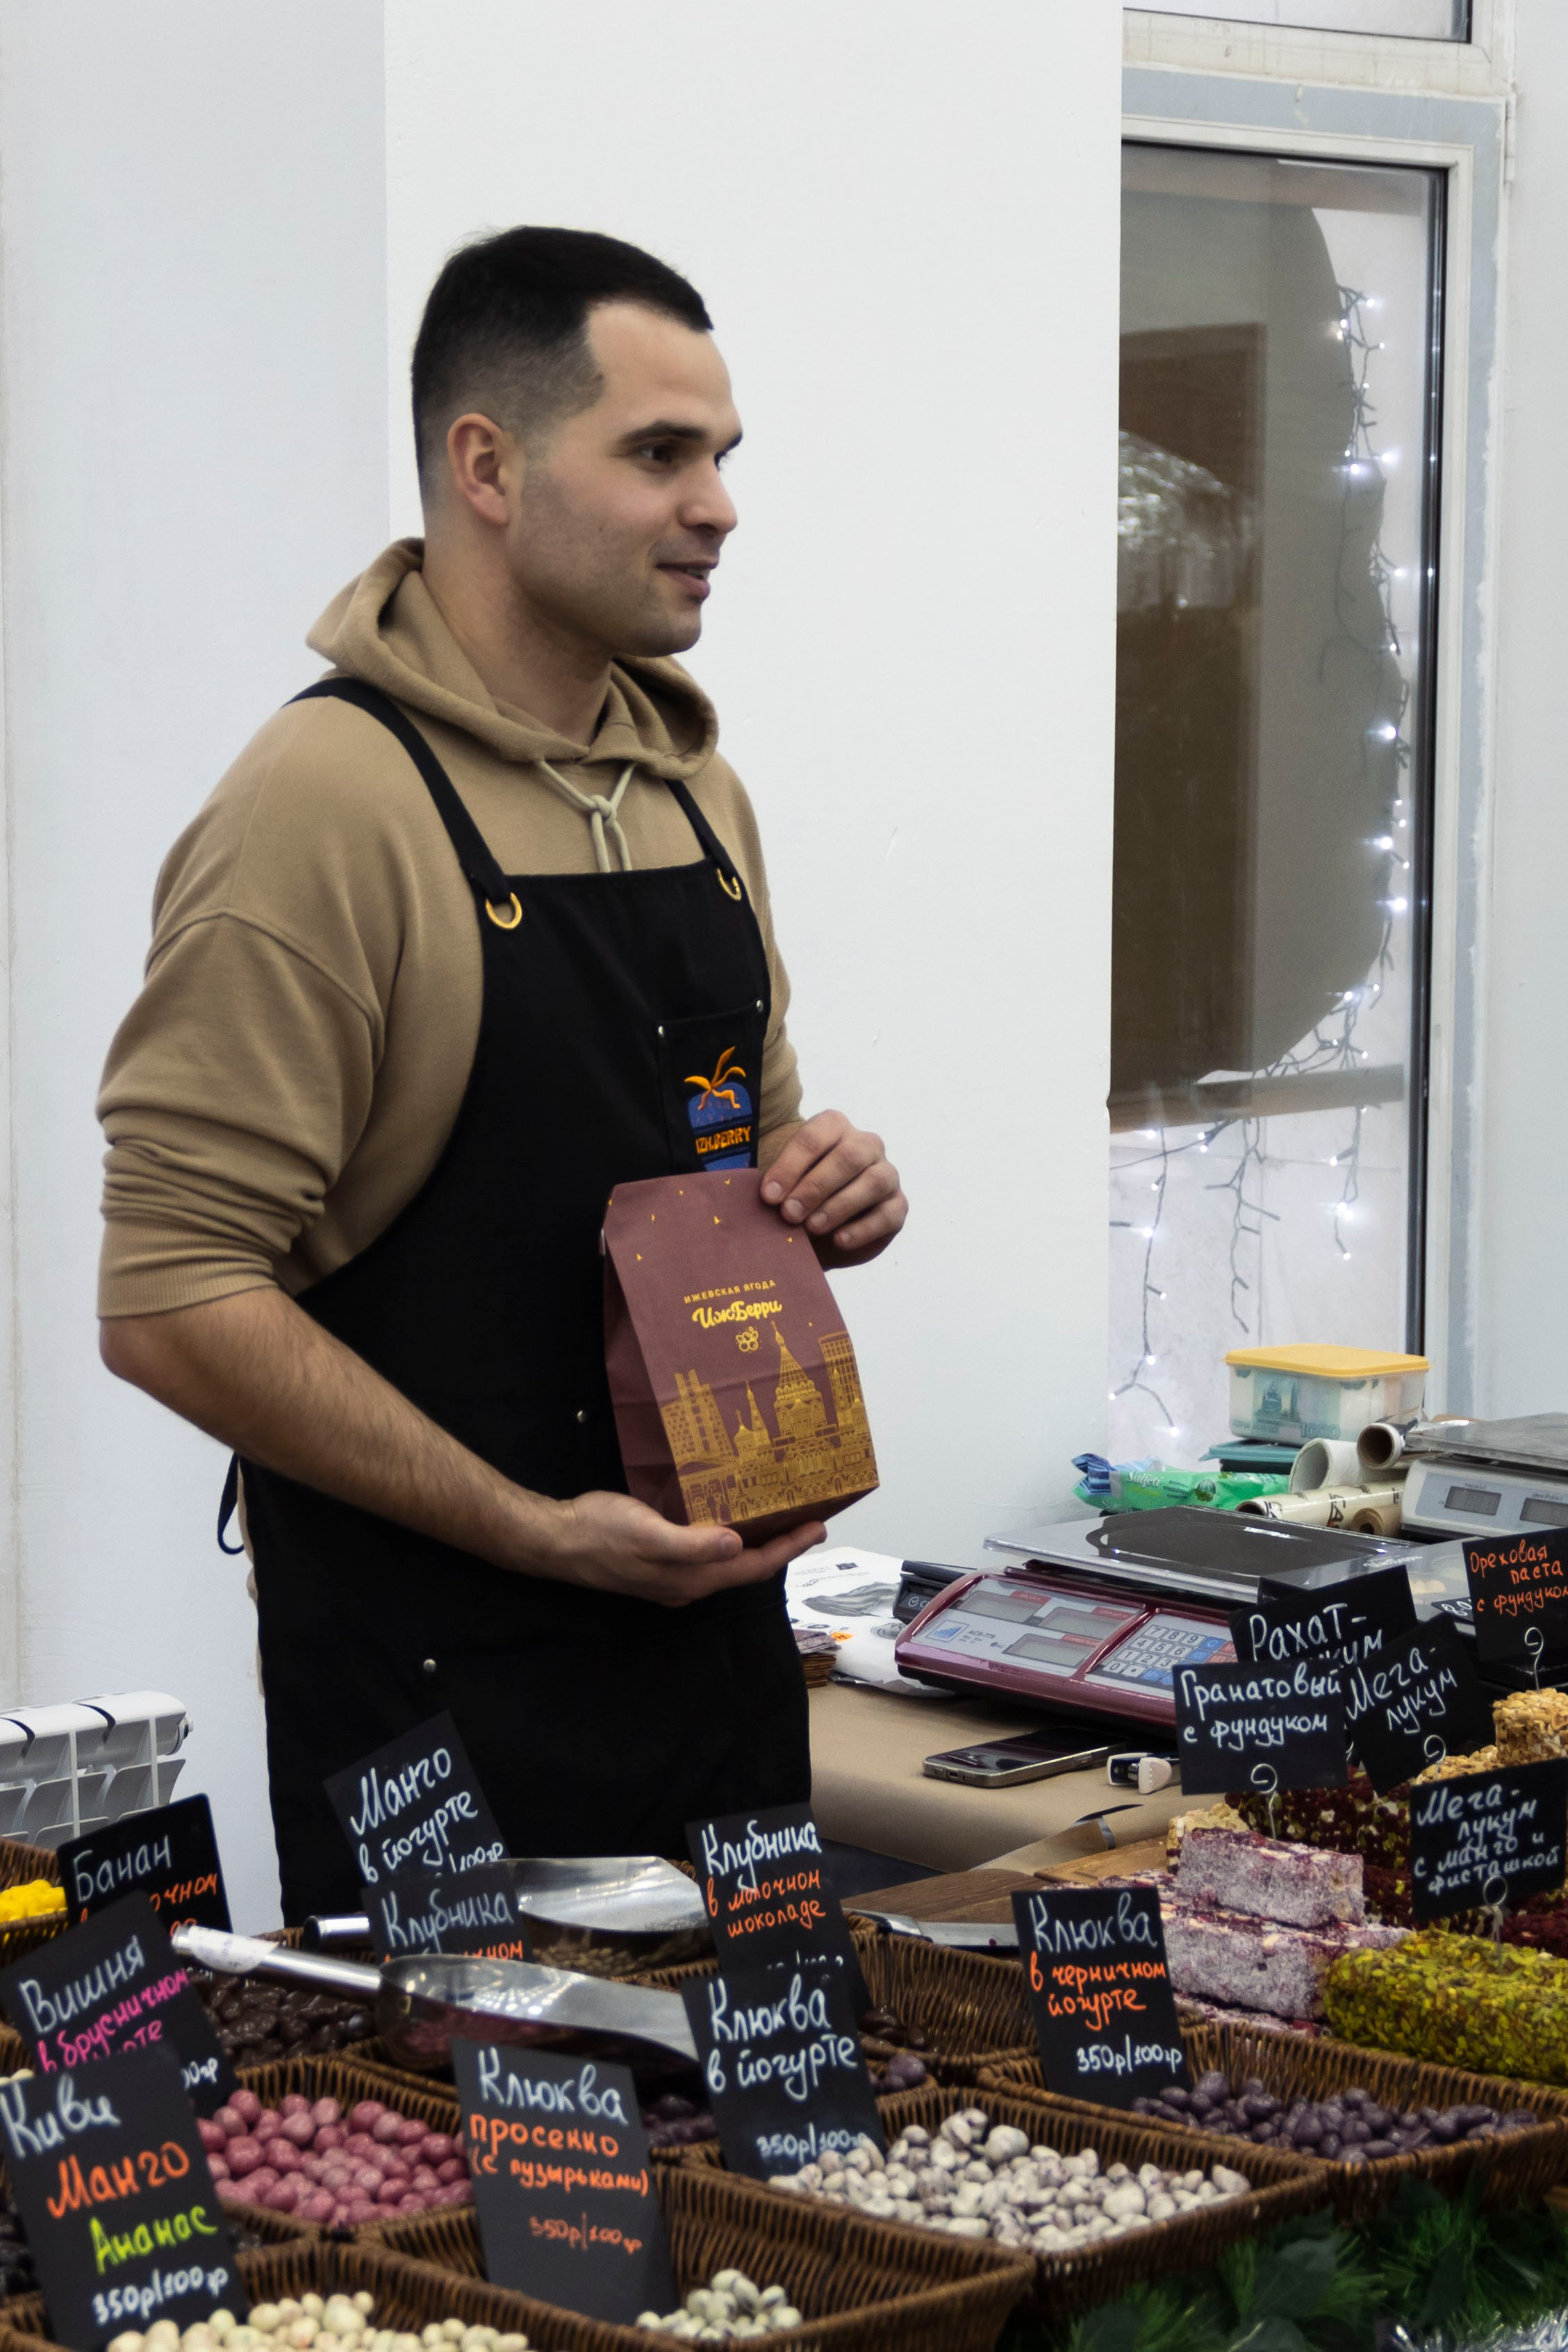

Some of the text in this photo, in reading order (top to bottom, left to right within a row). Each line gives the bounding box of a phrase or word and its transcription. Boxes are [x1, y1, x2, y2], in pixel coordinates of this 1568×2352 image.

[684, 1279, 776, 1304] ИЖЕВСКАЯ ЯГОДА
[692, 1300, 782, 1329] ИжБерри
[1470, 1538, 1548, 1579] Ореховая
[1510, 1560, 1564, 1585] паста
[1137, 1639, 1147, 1648] 4
[1155, 1644, 1165, 1652] 5
[1141, 1655, 1153, 1664] 2
[1161, 1659, 1171, 1668] 3
[1150, 1627, 1160, 1636] 7
[1169, 1631, 1179, 1640] 8
[1187, 1635, 1198, 1645] 9
[1109, 1663, 1120, 1671] 0
[1180, 1661, 1342, 1721] Гранатовый
[1386, 1668, 1458, 1734] лукум
[1210, 1714, 1328, 1751] фундуком
[350, 1747, 452, 1836] Манго
[359, 1791, 479, 1884] в йогурте
[1458, 1799, 1537, 1851] лукум
[73, 1834, 172, 1903] Банан
[701, 1819, 823, 1893] Клубника
[1428, 1845, 1560, 1896] фисташкой
[1437, 1836, 1518, 1873] манго
[1532, 1832, 1544, 1843] и
[707, 1868, 821, 1918] в молочном
[381, 1888, 515, 1955] Клубника
[727, 1900, 827, 1939] шоколаде
[1028, 1891, 1158, 1953] Клюква
[19, 1934, 146, 2034] Вишня
[1030, 1950, 1167, 1995] в черничном
[708, 1973, 832, 2042] Клюква
[1047, 1988, 1147, 2031] йогурте
[477, 2046, 629, 2127] Клюква
[707, 2034, 859, 2103] в йогурте
[0, 2073, 122, 2160] Киви
[45, 2141, 190, 2219] Манго
[88, 2205, 218, 2276] Ананас
